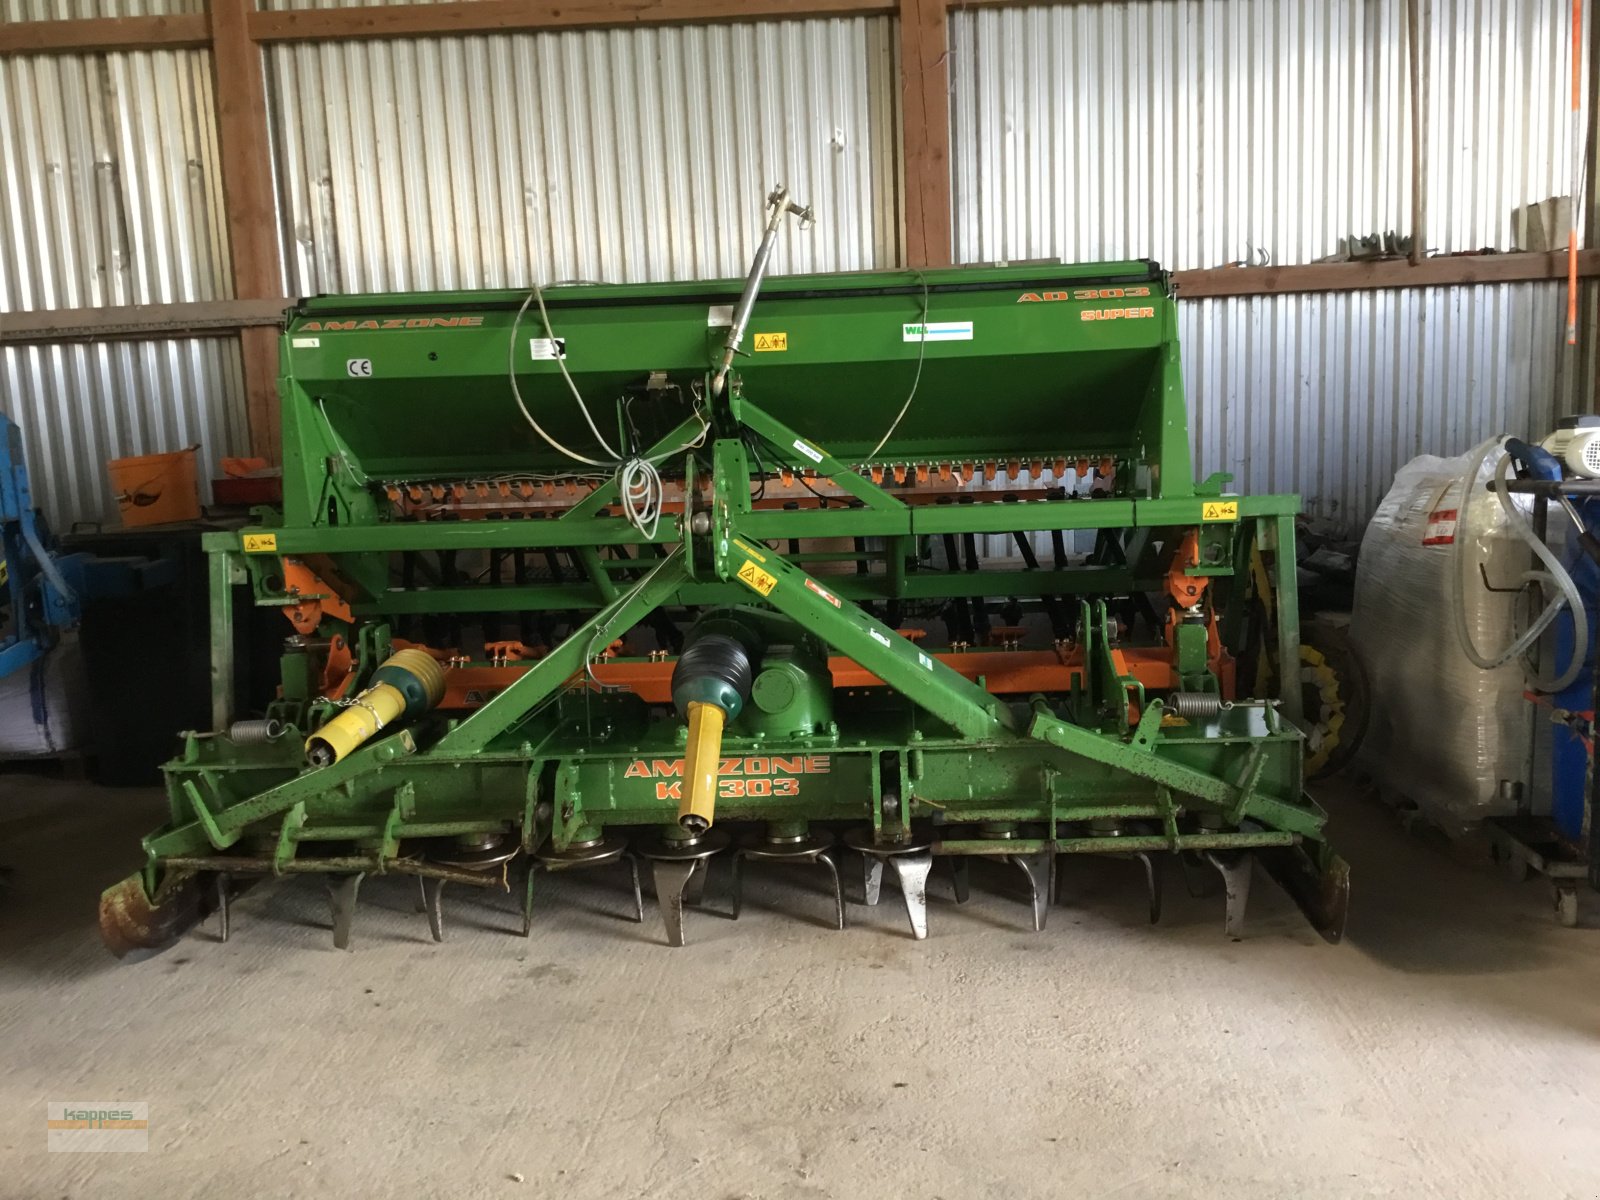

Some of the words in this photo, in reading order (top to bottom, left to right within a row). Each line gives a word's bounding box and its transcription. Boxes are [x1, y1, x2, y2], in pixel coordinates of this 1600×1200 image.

[1017, 291, 1068, 303] AD
[1073, 287, 1150, 300] 303
[1080, 307, 1155, 321] SUPER
[298, 316, 485, 332] AMAZONE
[349, 360, 371, 376] CE
[624, 755, 831, 778] AMZONE
[718, 778, 800, 797] 303
